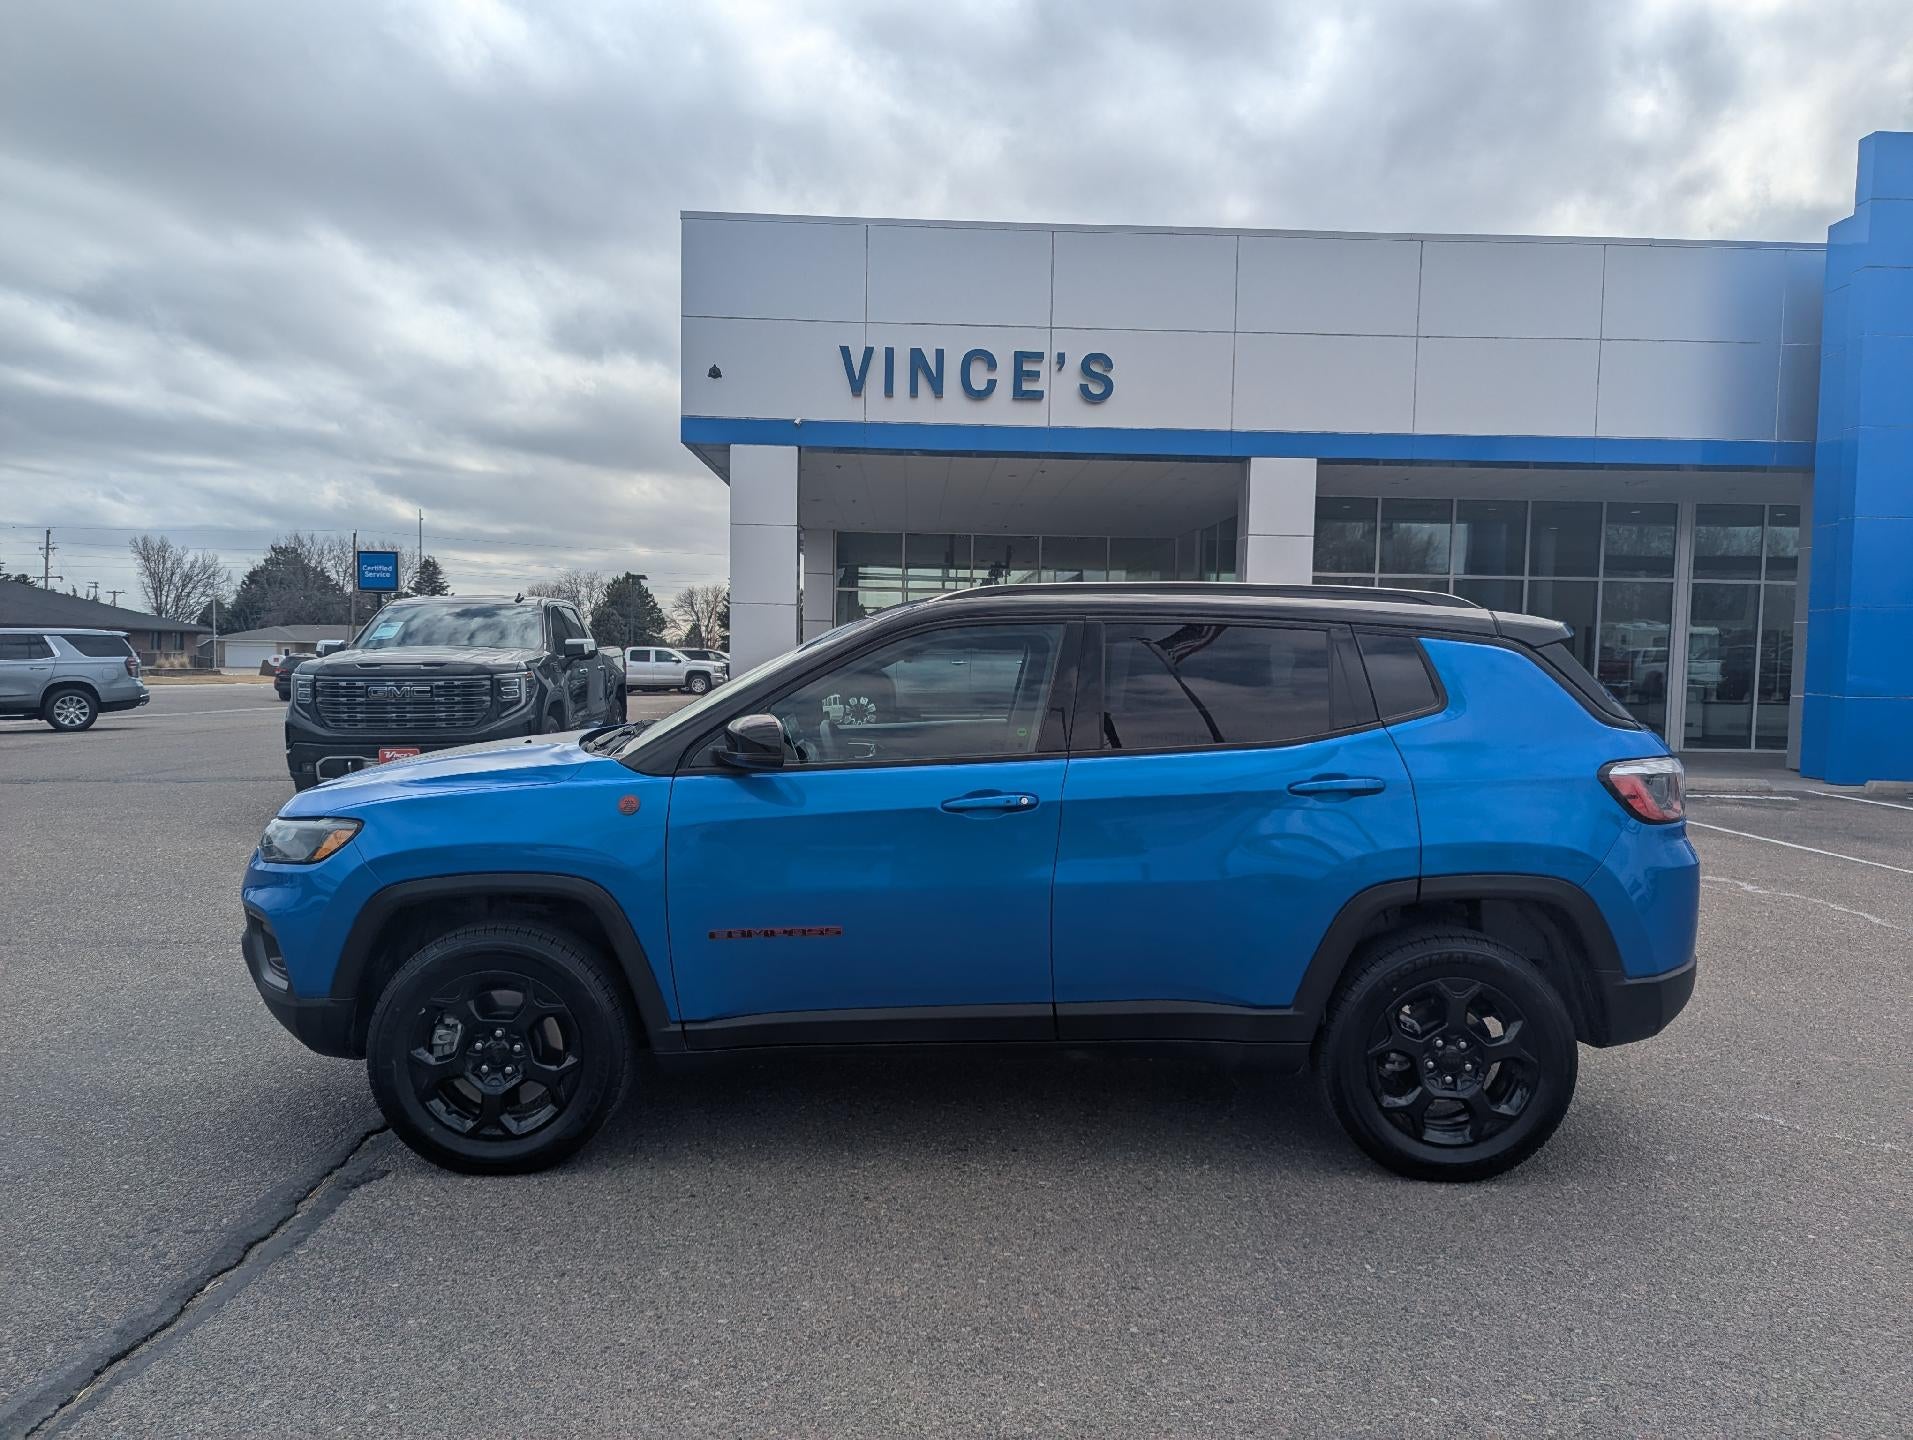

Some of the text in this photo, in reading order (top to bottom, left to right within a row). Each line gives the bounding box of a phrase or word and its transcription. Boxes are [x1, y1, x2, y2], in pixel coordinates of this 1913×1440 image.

[839, 345, 1115, 403] VINCE'S
[362, 564, 393, 572] Certified
[368, 686, 431, 699] GMC
[708, 925, 843, 940] COMPASS
